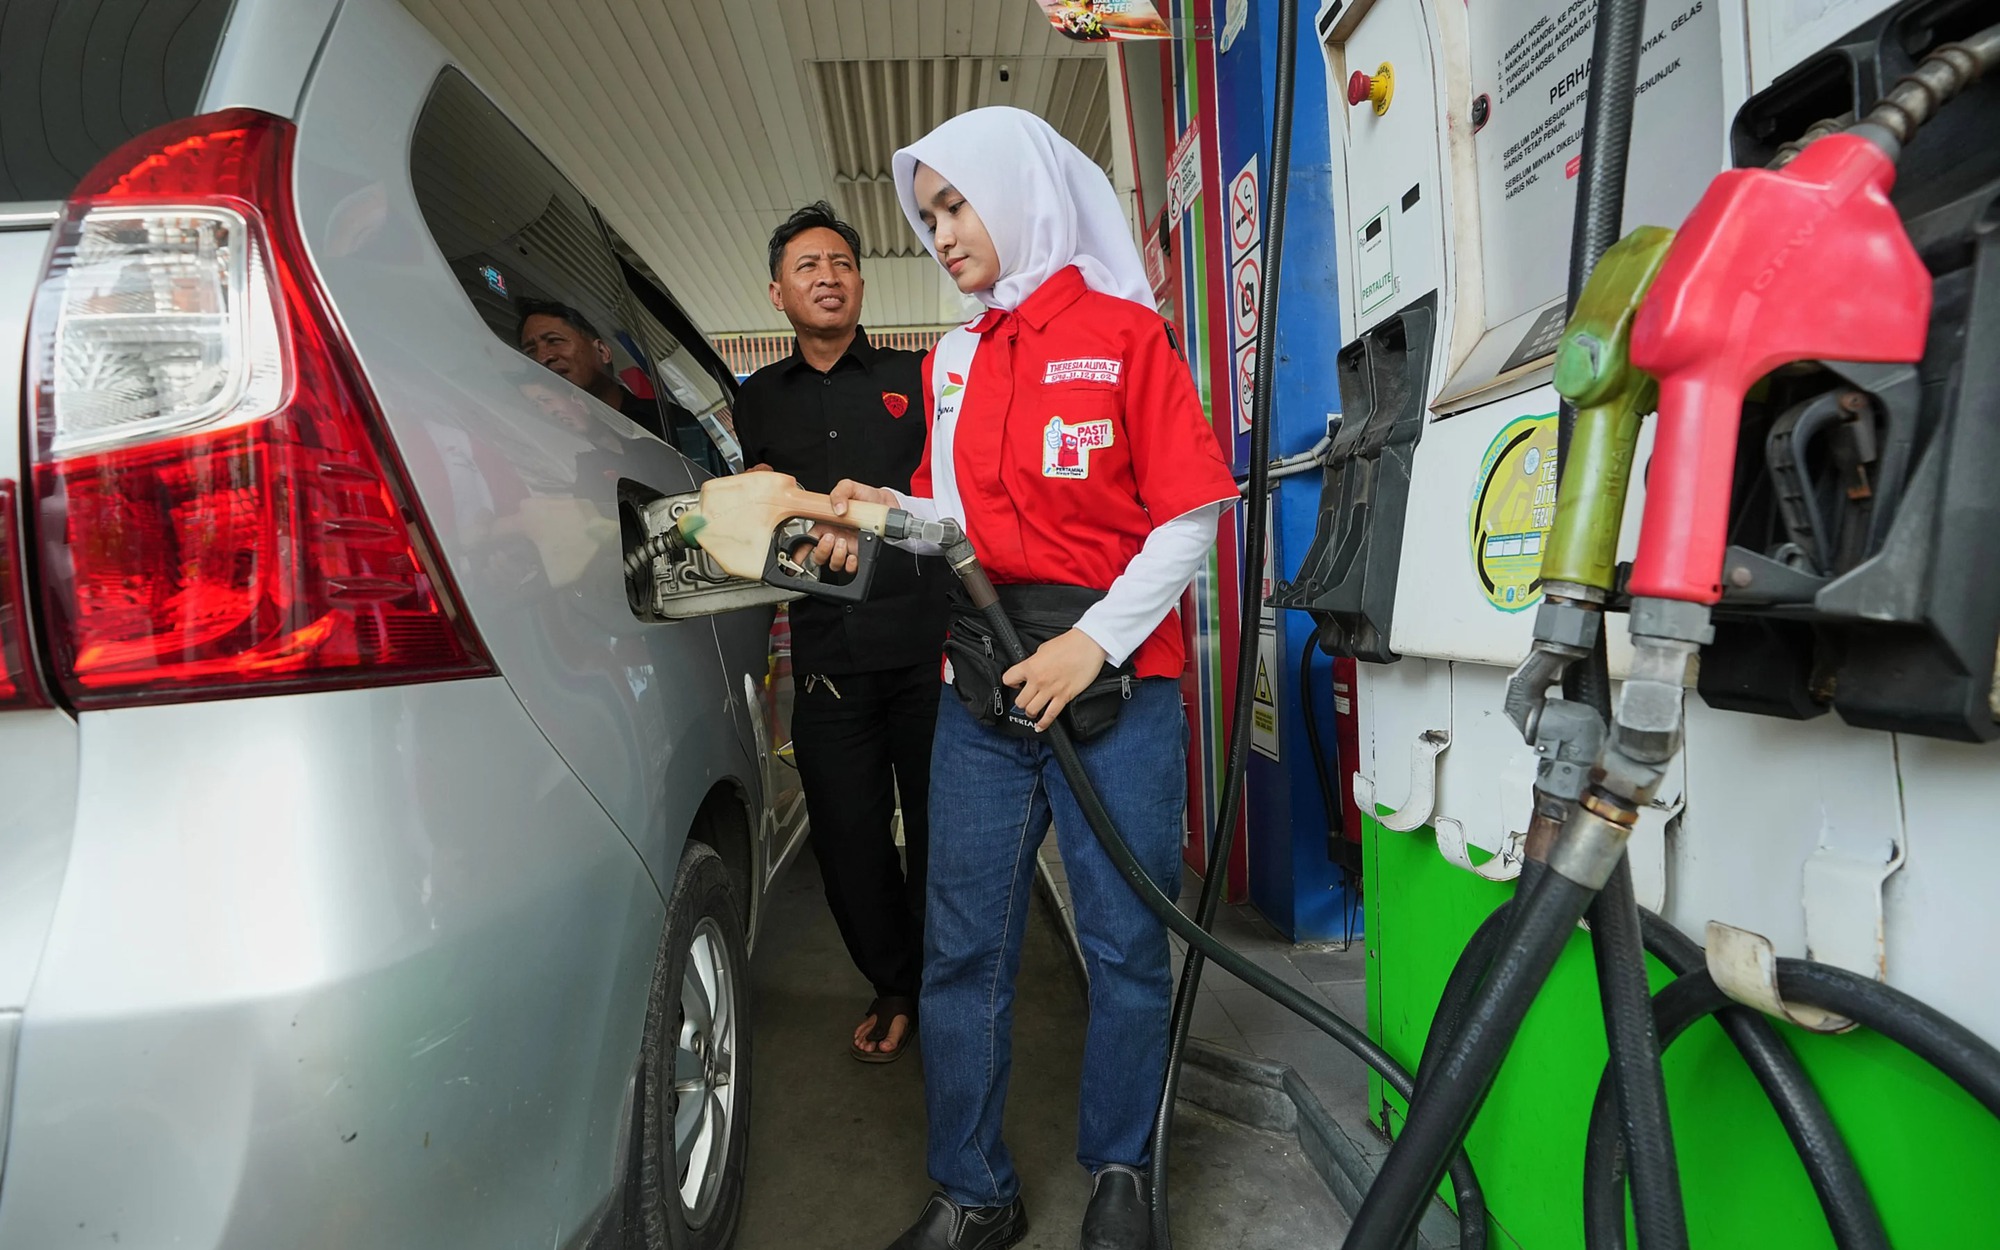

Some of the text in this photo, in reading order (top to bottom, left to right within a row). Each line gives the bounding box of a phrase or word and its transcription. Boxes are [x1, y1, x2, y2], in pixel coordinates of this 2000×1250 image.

[1093, 3, 1132, 14] FASTER
[1671, 1, 1702, 31] GELAS
[1505, 45, 1530, 73] NAIKKAN
[1532, 22, 1556, 49] HANDEL
[1558, 11, 1566, 25] KE
[1505, 33, 1527, 61] ANGKAT
[1506, 60, 1529, 85] TUNGGU
[1531, 38, 1553, 64] SAMPAI
[1555, 17, 1578, 43] ANGKA
[1579, 8, 1586, 21] DI
[1507, 69, 1534, 99] ARAHKAN
[1536, 52, 1556, 74] NOSEL
[1557, 20, 1591, 55] KETANGKI
[1634, 57, 1681, 98] PENUNJUK
[1503, 134, 1530, 161] SEBELUM
[1530, 123, 1544, 140] DAN
[1545, 100, 1575, 129] SESUDAH
[1504, 151, 1523, 171] HARUS
[1524, 136, 1542, 156] TETAP
[1505, 165, 1531, 190] SEBELUM
[1532, 148, 1555, 172] MINYAK
[1505, 173, 1540, 201] HARUS NOL.
[1362, 271, 1392, 301] PERTALITE
[1077, 424, 1108, 437] PASTI
[1080, 435, 1104, 447] PAS!
[1474, 434, 1508, 501] METROLOGI
[1531, 507, 1548, 529] TERA
